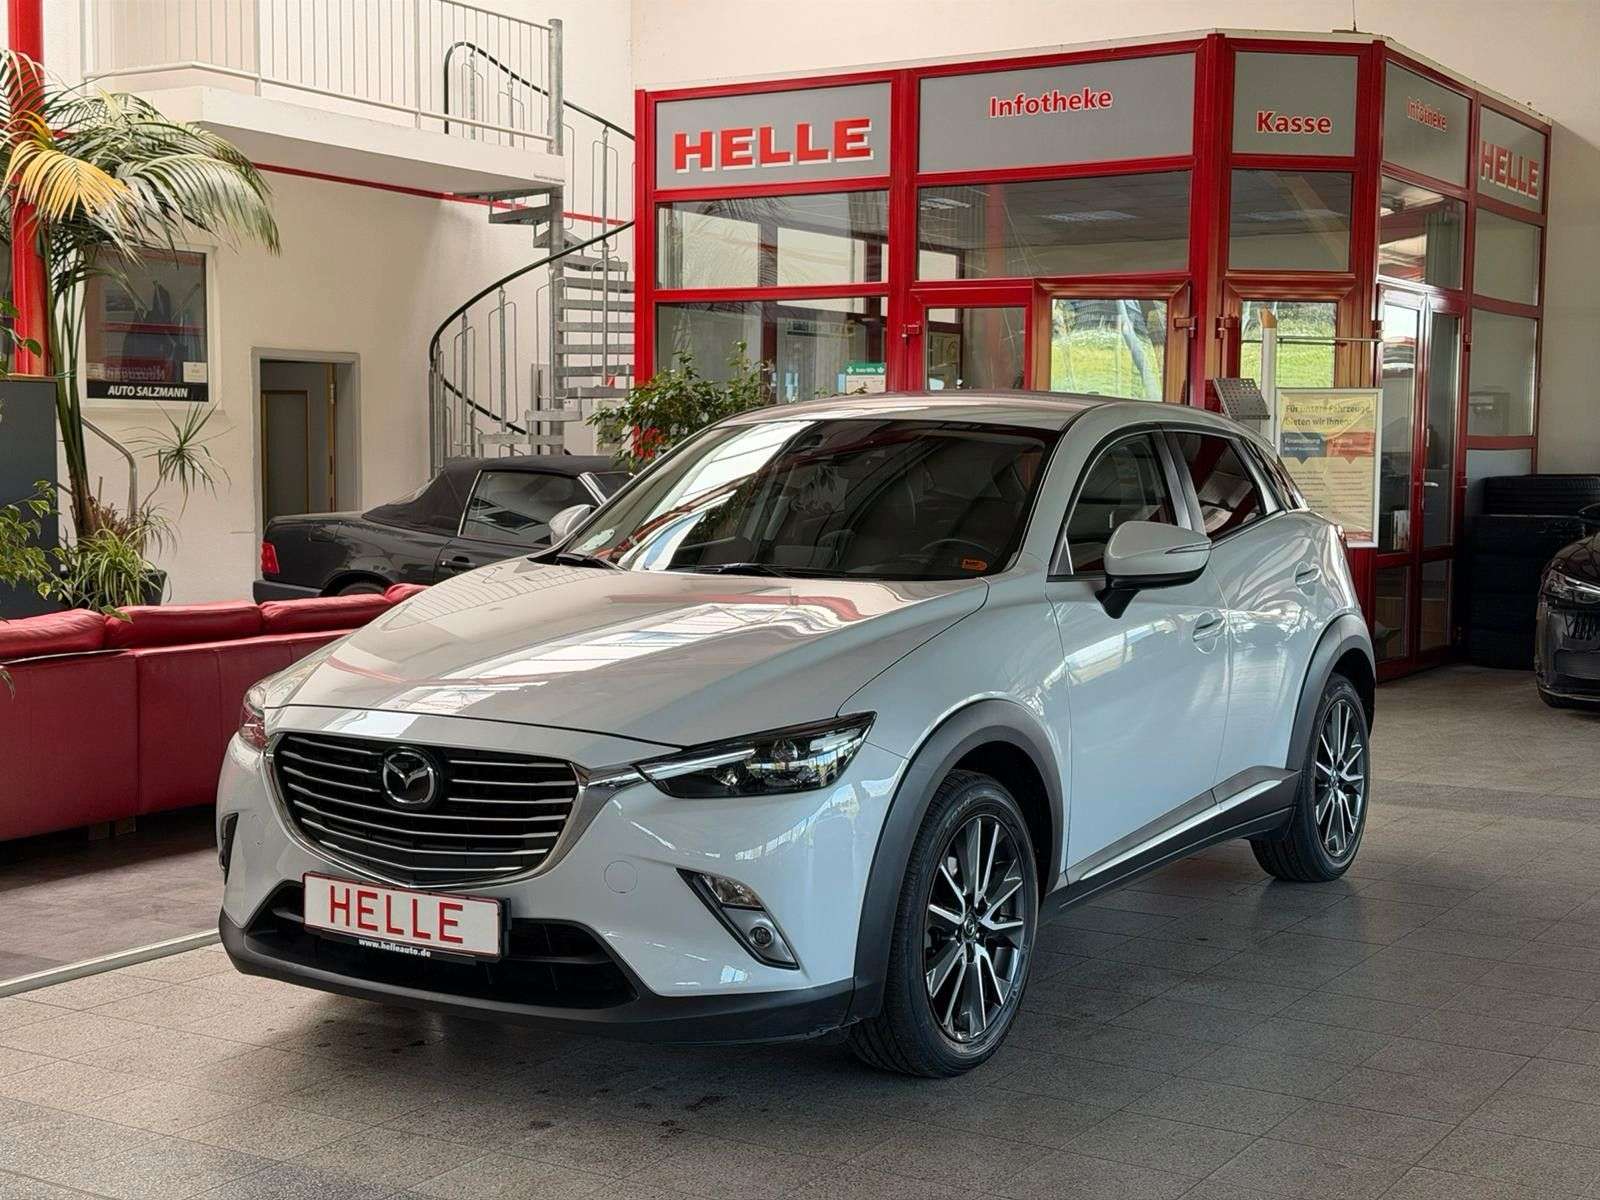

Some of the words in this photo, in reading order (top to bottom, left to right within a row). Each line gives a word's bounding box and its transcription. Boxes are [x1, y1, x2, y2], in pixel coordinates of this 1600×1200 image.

[988, 87, 1114, 119] Infotheke
[1256, 110, 1333, 135] Kasse
[673, 117, 874, 174] HELLE
[1480, 141, 1539, 199] HELLE
[107, 385, 136, 397] AUTO
[137, 386, 189, 398] SALZMANN
[329, 885, 464, 945] HELLE
[358, 939, 431, 957] www.helleauto.de
